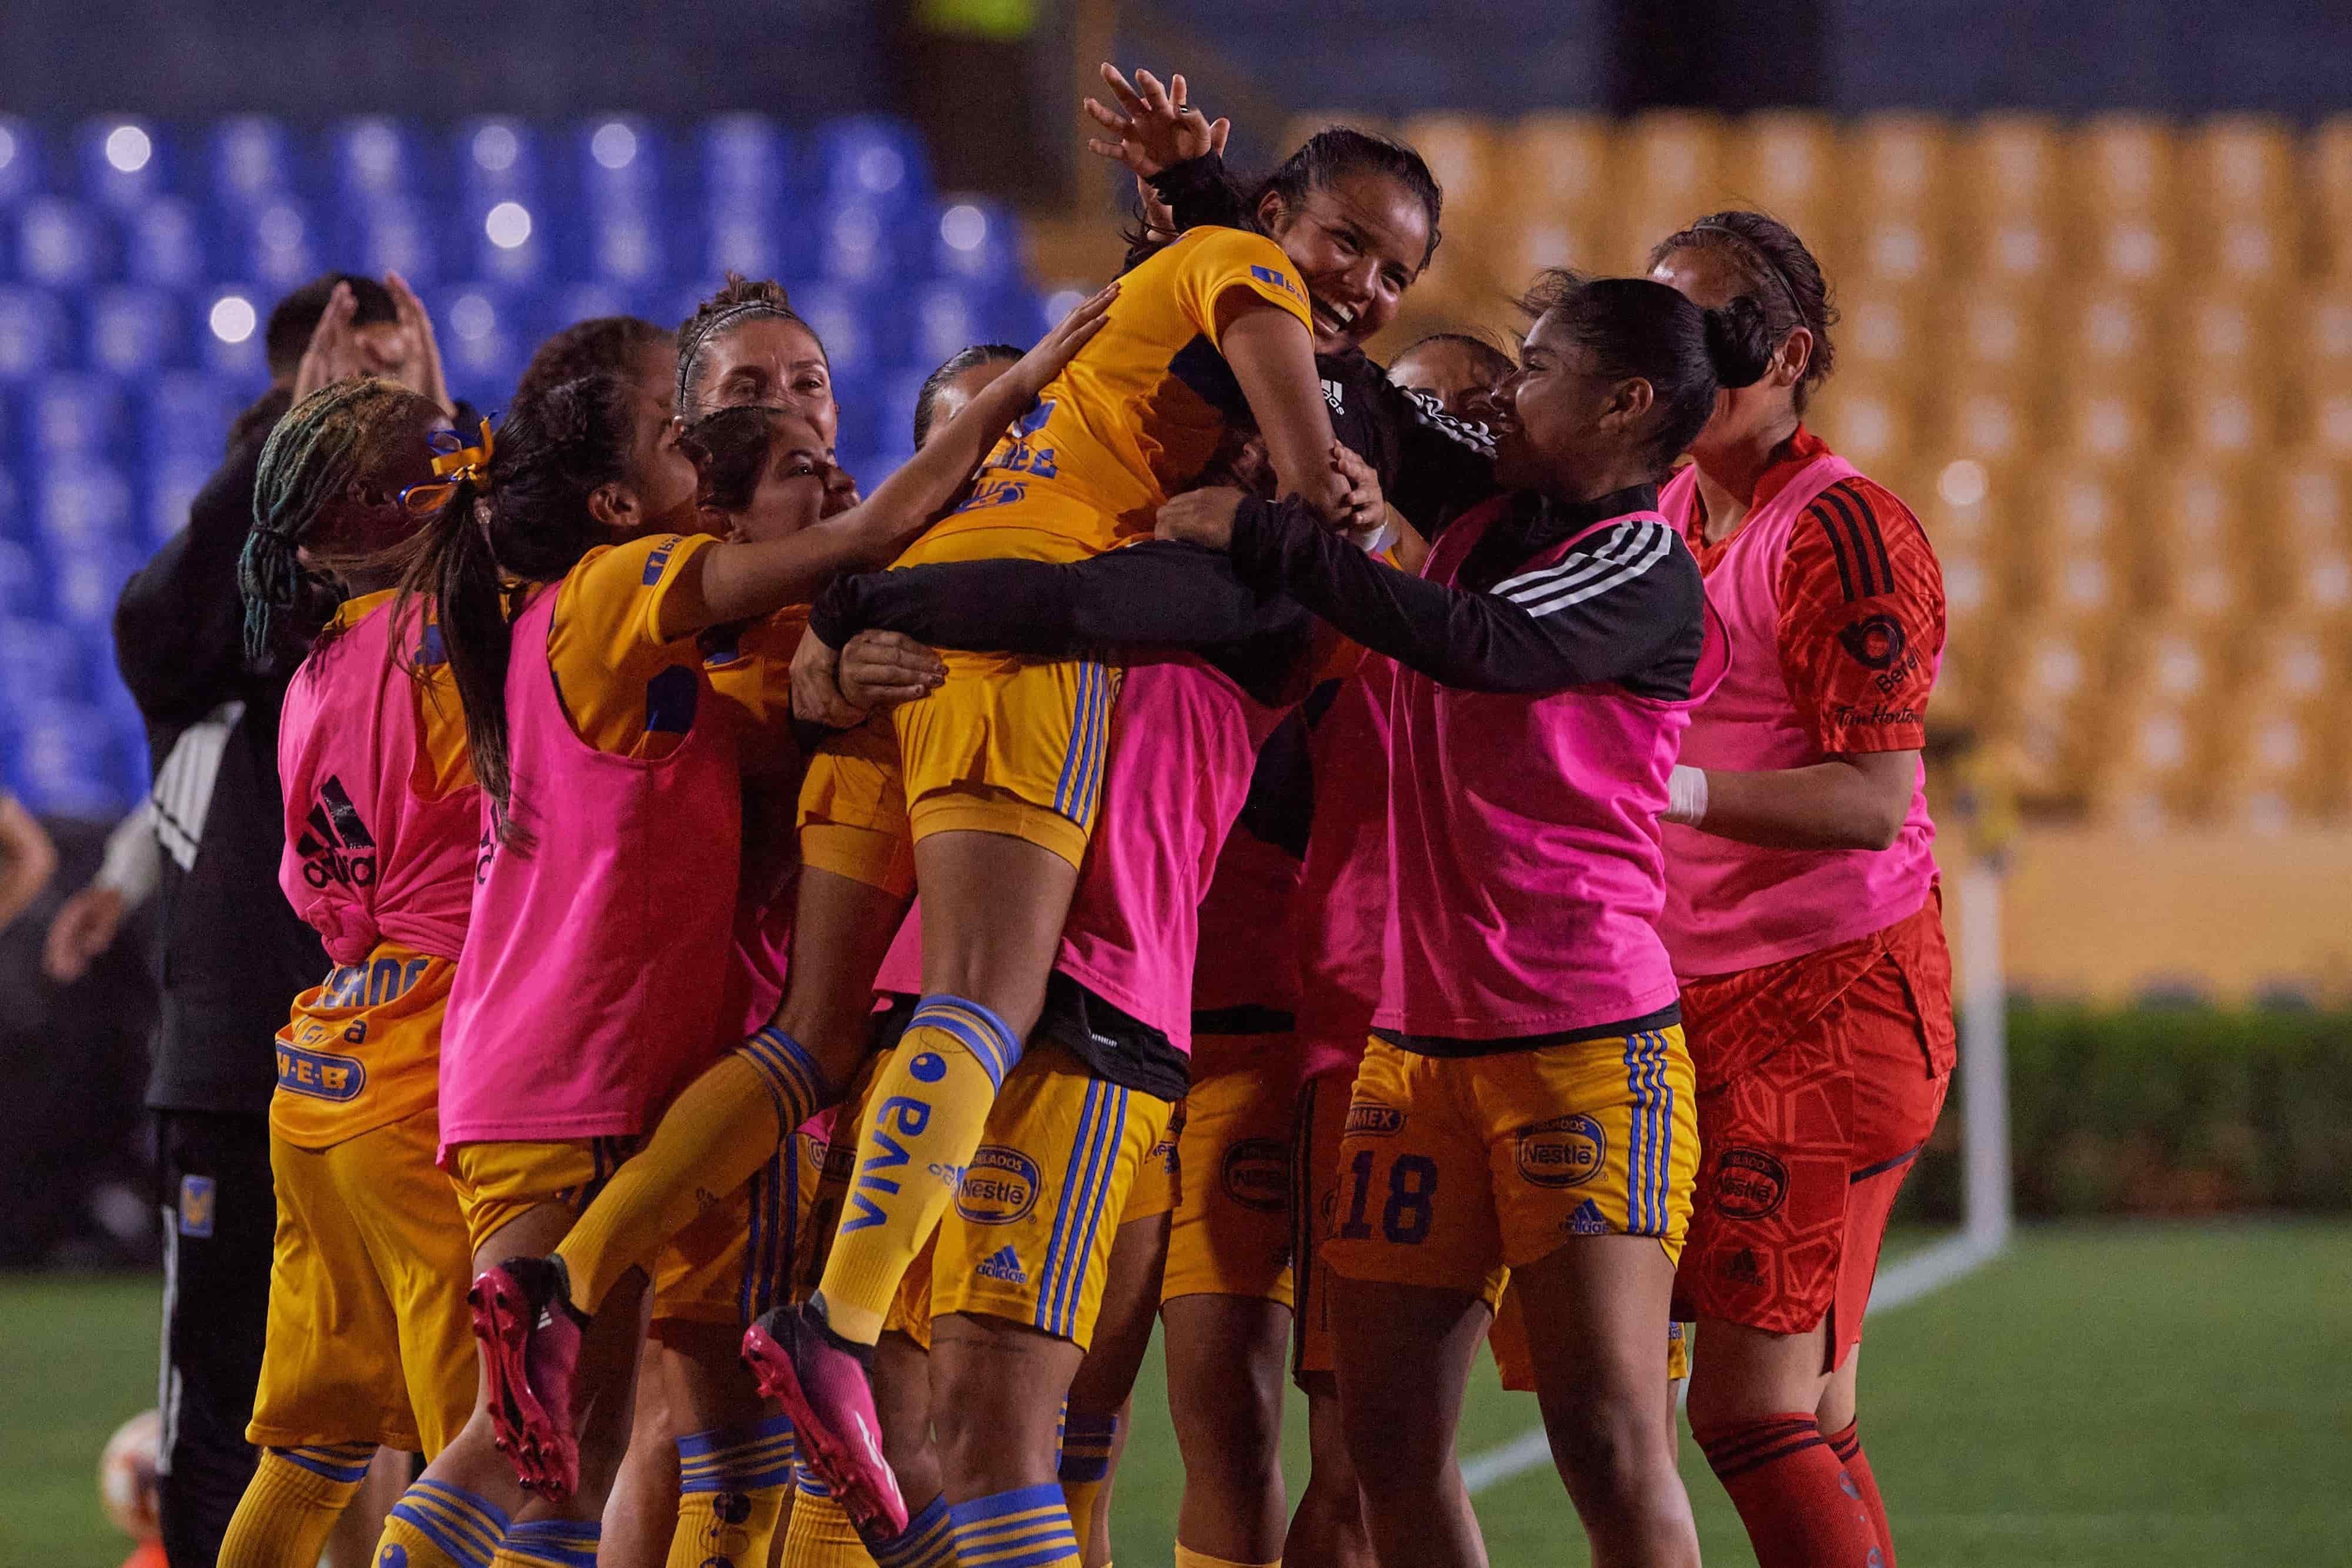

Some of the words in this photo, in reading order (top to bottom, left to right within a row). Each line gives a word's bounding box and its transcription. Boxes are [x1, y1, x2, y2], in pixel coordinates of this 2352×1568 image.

[840, 1095, 933, 1235] viva
[1345, 1108, 1392, 1129] MEX
[1341, 1151, 1438, 1245] 18
